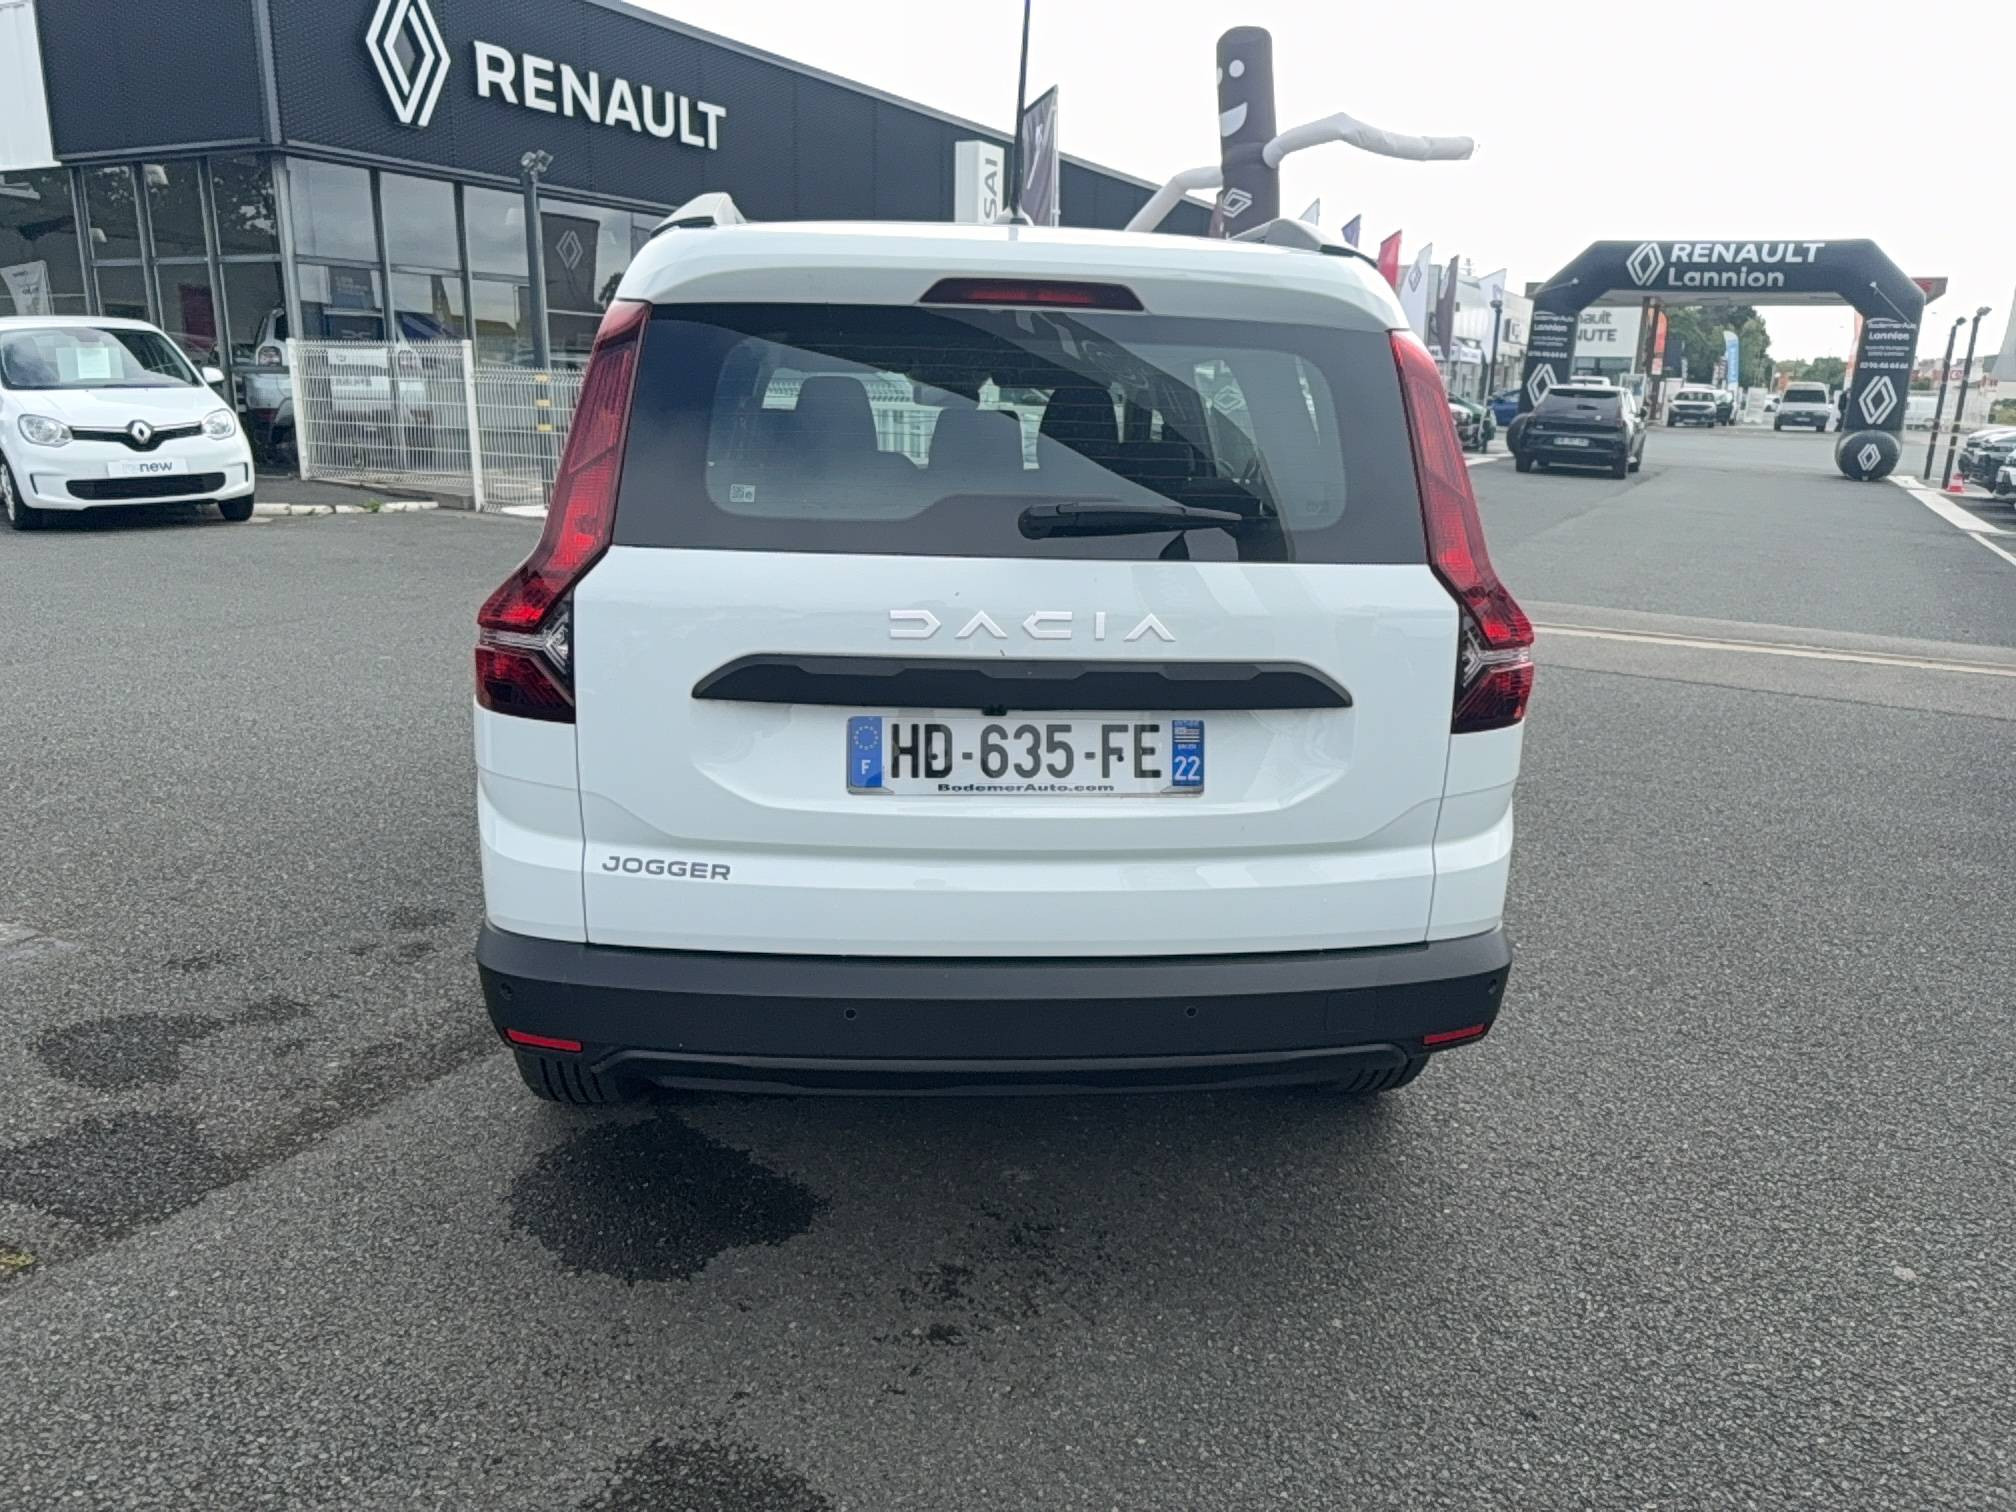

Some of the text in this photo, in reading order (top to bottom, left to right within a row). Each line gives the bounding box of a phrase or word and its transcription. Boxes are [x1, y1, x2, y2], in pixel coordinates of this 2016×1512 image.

[473, 40, 727, 150] RENAULT
[1669, 242, 1826, 264] RENAULT
[1667, 266, 1786, 287] Lannion
[889, 609, 1177, 641] DACIA
[891, 723, 1162, 780] HD-635-FE
[861, 760, 871, 775] F
[1174, 755, 1201, 781] 22
[937, 783, 1115, 793] BodemerAuto.com
[602, 855, 731, 880] JOGGER
